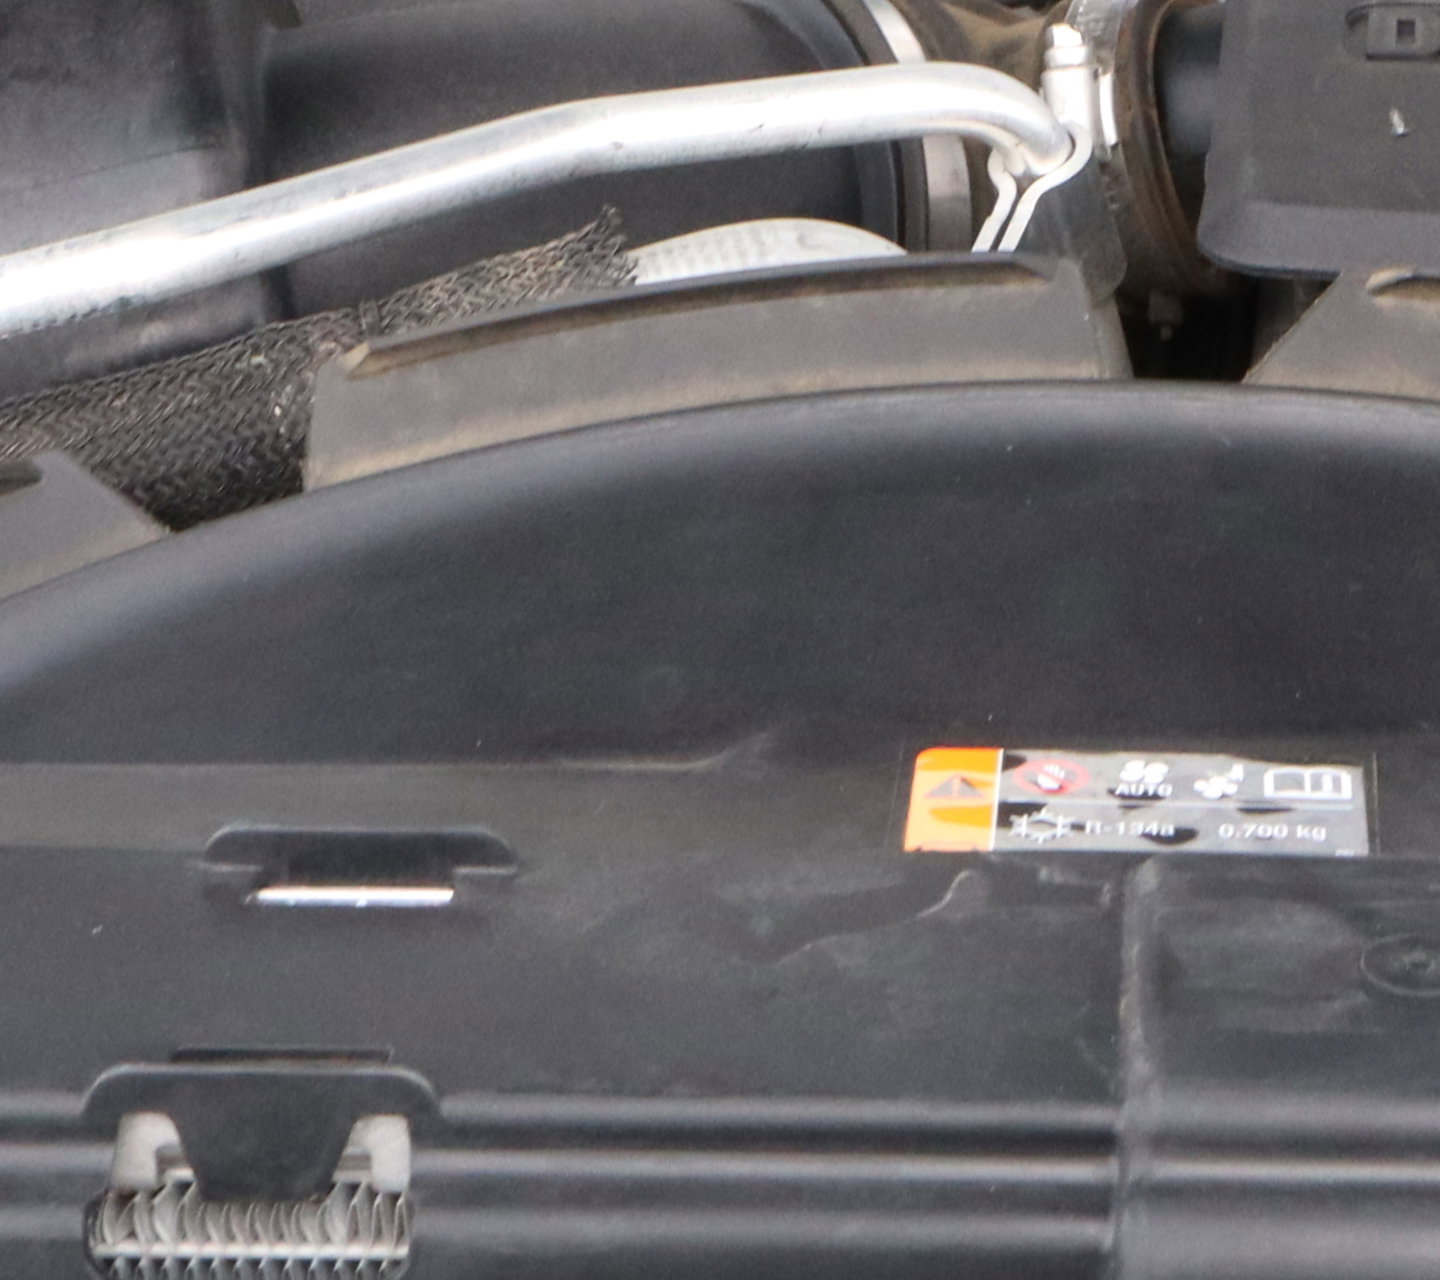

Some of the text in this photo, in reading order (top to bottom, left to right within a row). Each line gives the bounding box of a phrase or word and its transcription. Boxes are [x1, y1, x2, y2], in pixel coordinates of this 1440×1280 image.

[1114, 782, 1174, 798] AUTO
[1217, 822, 1289, 840] 0.700
[1296, 824, 1327, 842] kg
